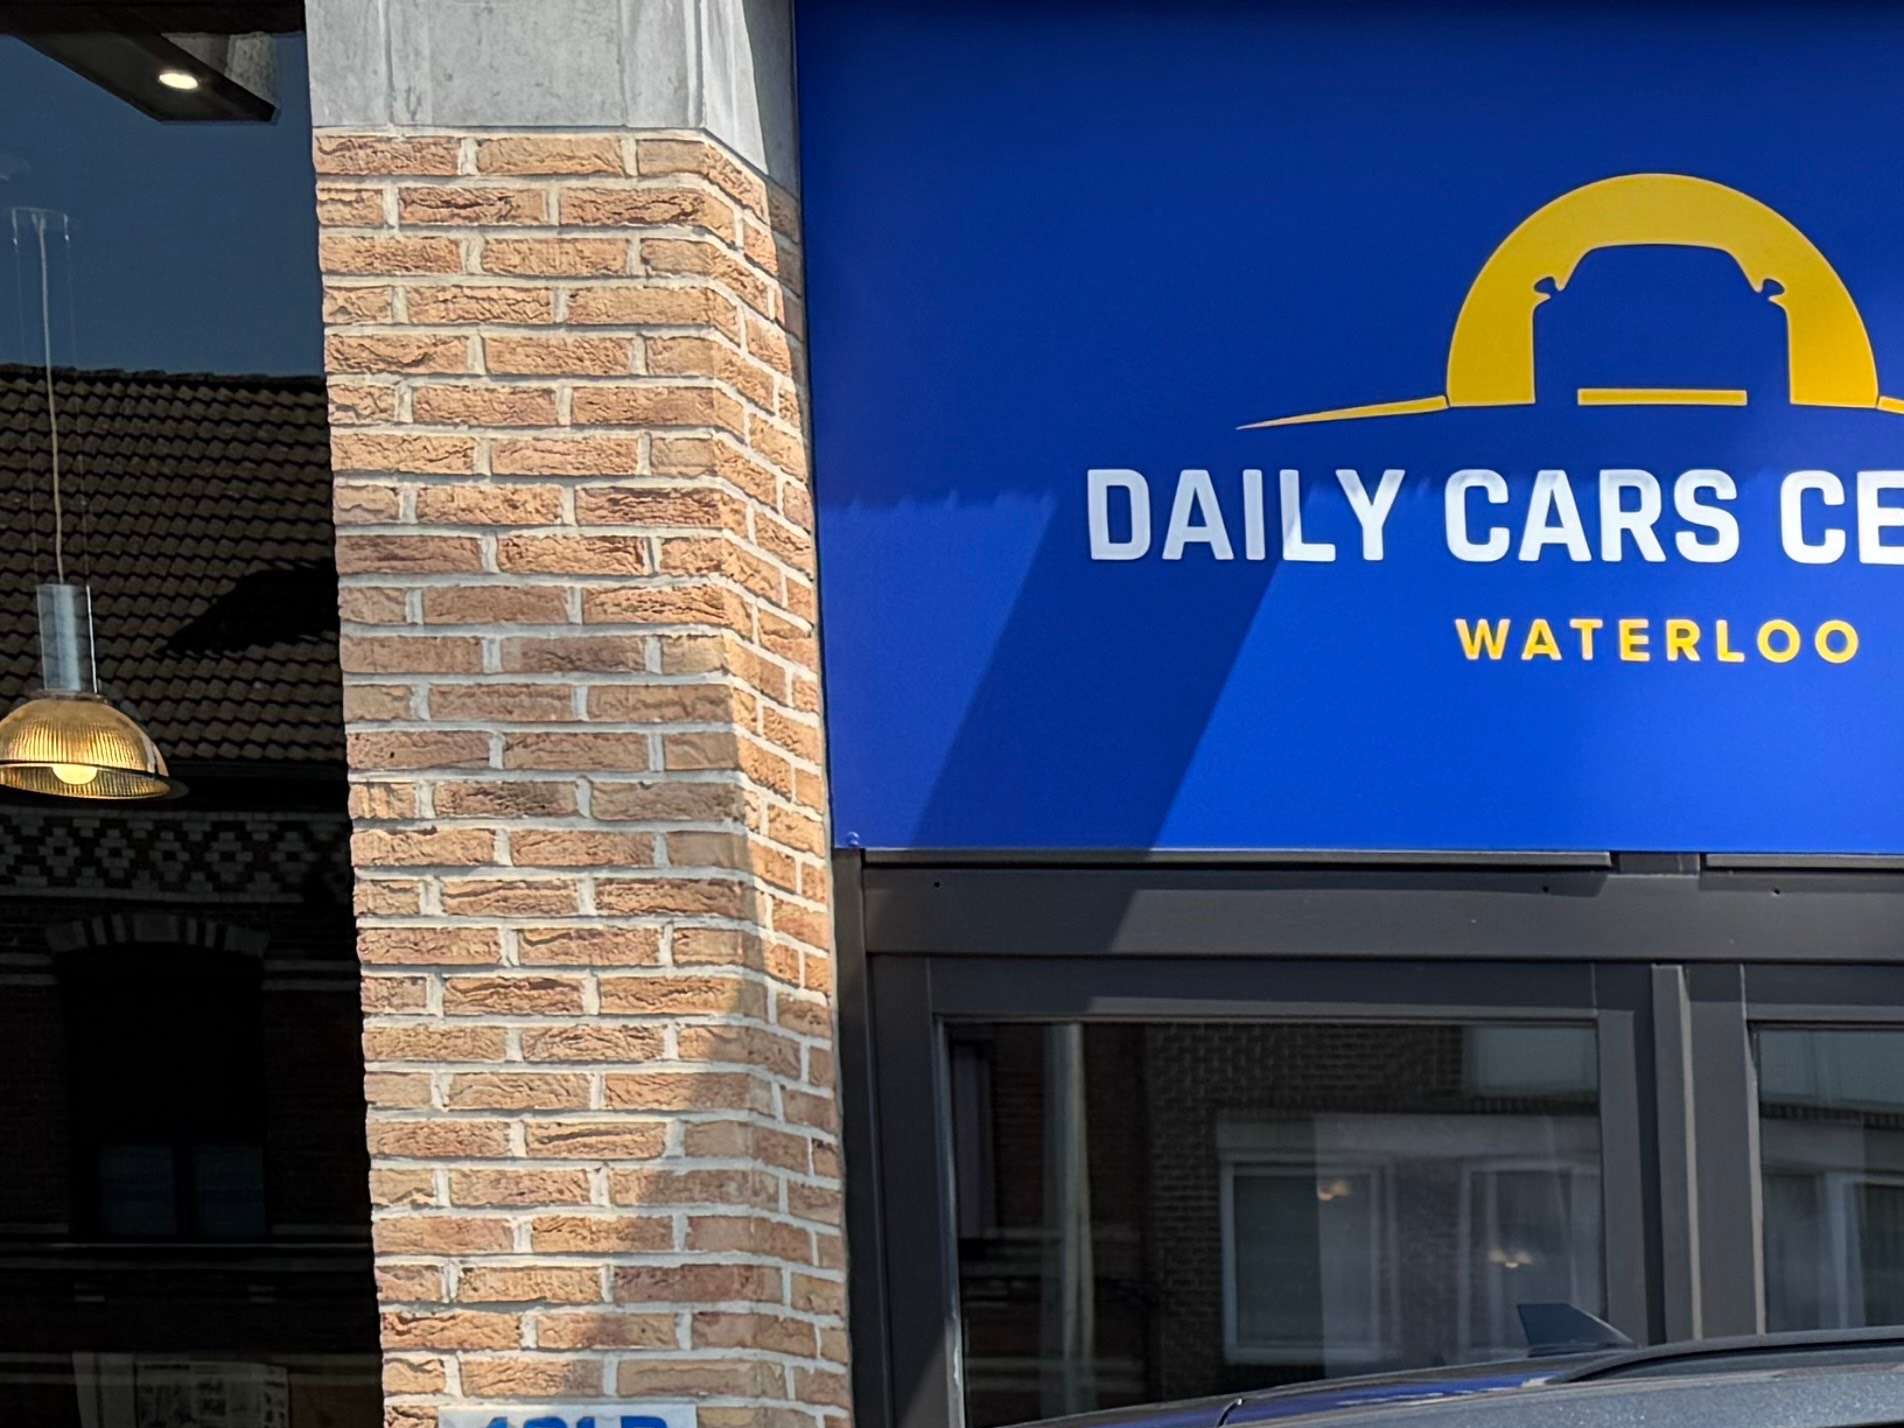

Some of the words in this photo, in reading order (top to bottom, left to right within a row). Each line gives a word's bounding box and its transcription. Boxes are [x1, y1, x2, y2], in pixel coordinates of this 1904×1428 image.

[1086, 467, 1406, 562] DAILY
[1443, 467, 1741, 564] CARS
[1454, 617, 1861, 665] WATERLOO
